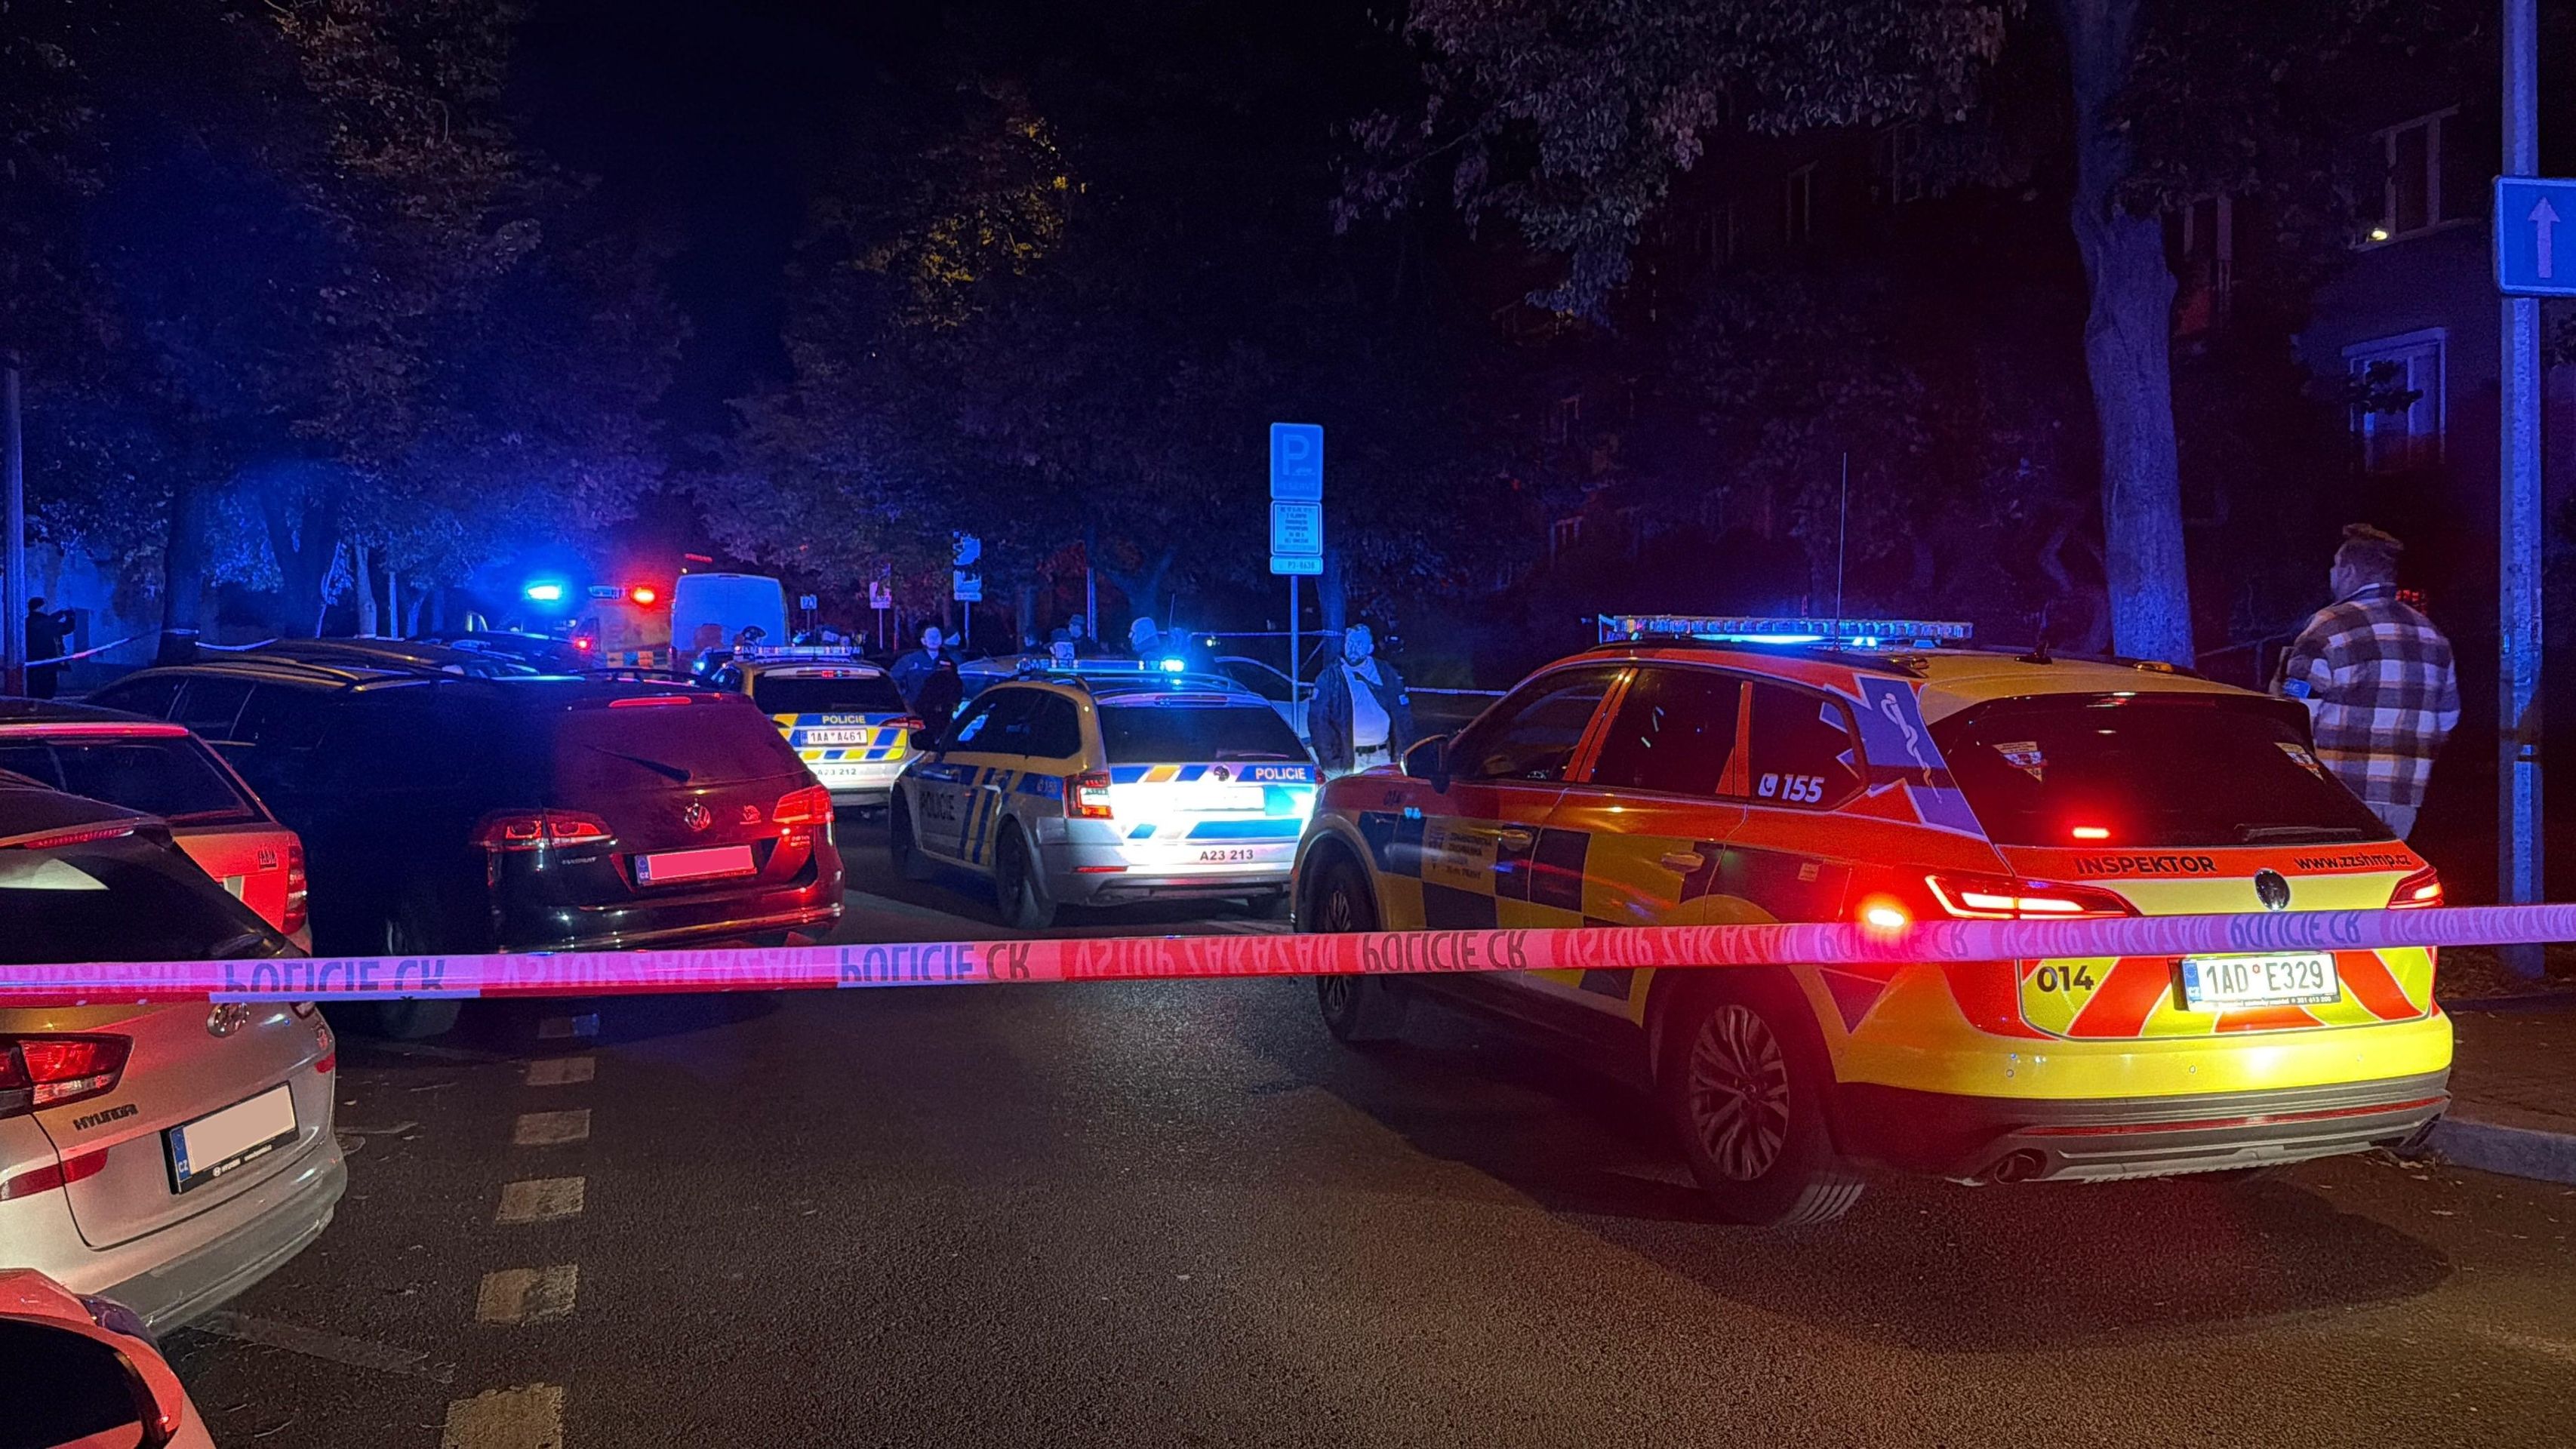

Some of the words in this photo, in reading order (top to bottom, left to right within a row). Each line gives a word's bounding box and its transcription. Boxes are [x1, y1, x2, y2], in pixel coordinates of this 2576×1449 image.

[822, 715, 866, 724] POLICIE
[811, 731, 829, 743] 1AA
[837, 731, 863, 742] A461
[839, 768, 857, 776] 212
[1255, 767, 1306, 780] POLICIE
[1781, 774, 1825, 804] 155
[1199, 851, 1226, 861] A23
[1230, 849, 1254, 860] 213
[2074, 856, 2218, 875] INSPEKTOR
[2295, 853, 2411, 871] www.zzshmp.cz
[2036, 965, 2094, 992] 014
[2206, 963, 2248, 994] 1AD
[2265, 959, 2325, 991] E329
[177, 1160, 189, 1173] CZ
